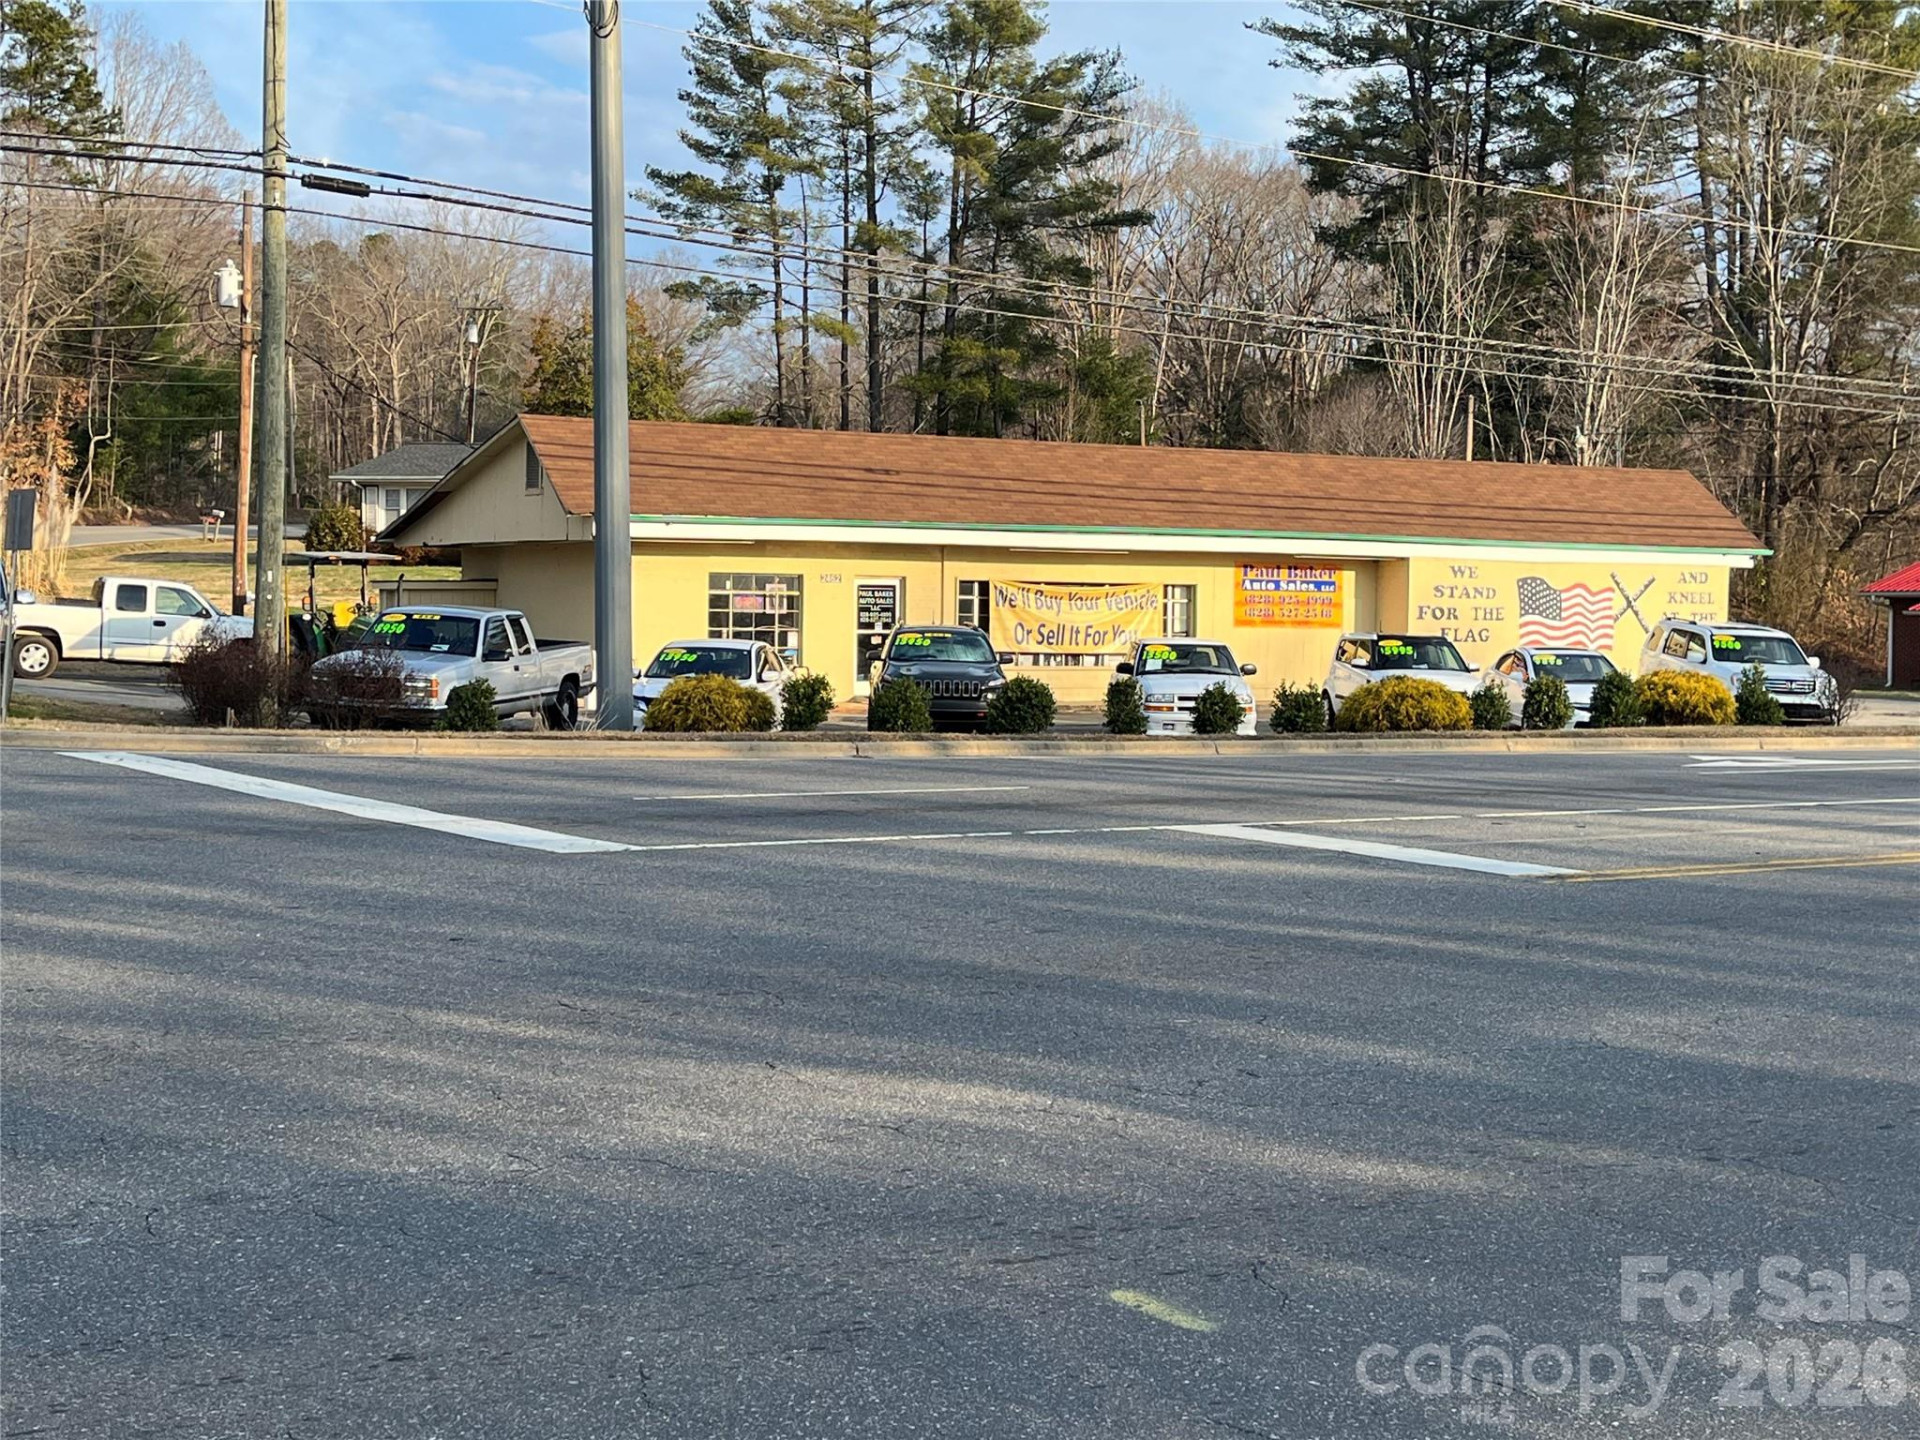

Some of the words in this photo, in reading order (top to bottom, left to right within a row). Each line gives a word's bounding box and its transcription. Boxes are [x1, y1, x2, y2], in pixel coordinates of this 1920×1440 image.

[1243, 564, 1281, 579] Paul
[1288, 565, 1336, 580] Baker
[1450, 565, 1478, 579] WE
[1678, 572, 1709, 584] AND
[1243, 580, 1276, 591] Auto
[1433, 585, 1497, 599] STAND
[993, 584, 1031, 610] We'll
[1034, 588, 1062, 615] Buy
[1067, 591, 1100, 611] Your
[1105, 589, 1158, 611] Vehicle
[1245, 595, 1275, 605] (828)
[1668, 592, 1715, 604] KNEEL
[1245, 608, 1275, 618] (828)
[1416, 605, 1459, 620] FOR
[1471, 606, 1505, 621] THE
[1013, 622, 1032, 645] Or
[1036, 622, 1066, 647] Sell
[1069, 624, 1080, 646] It
[1084, 624, 1108, 646] For
[1440, 627, 1490, 643] FLAG
